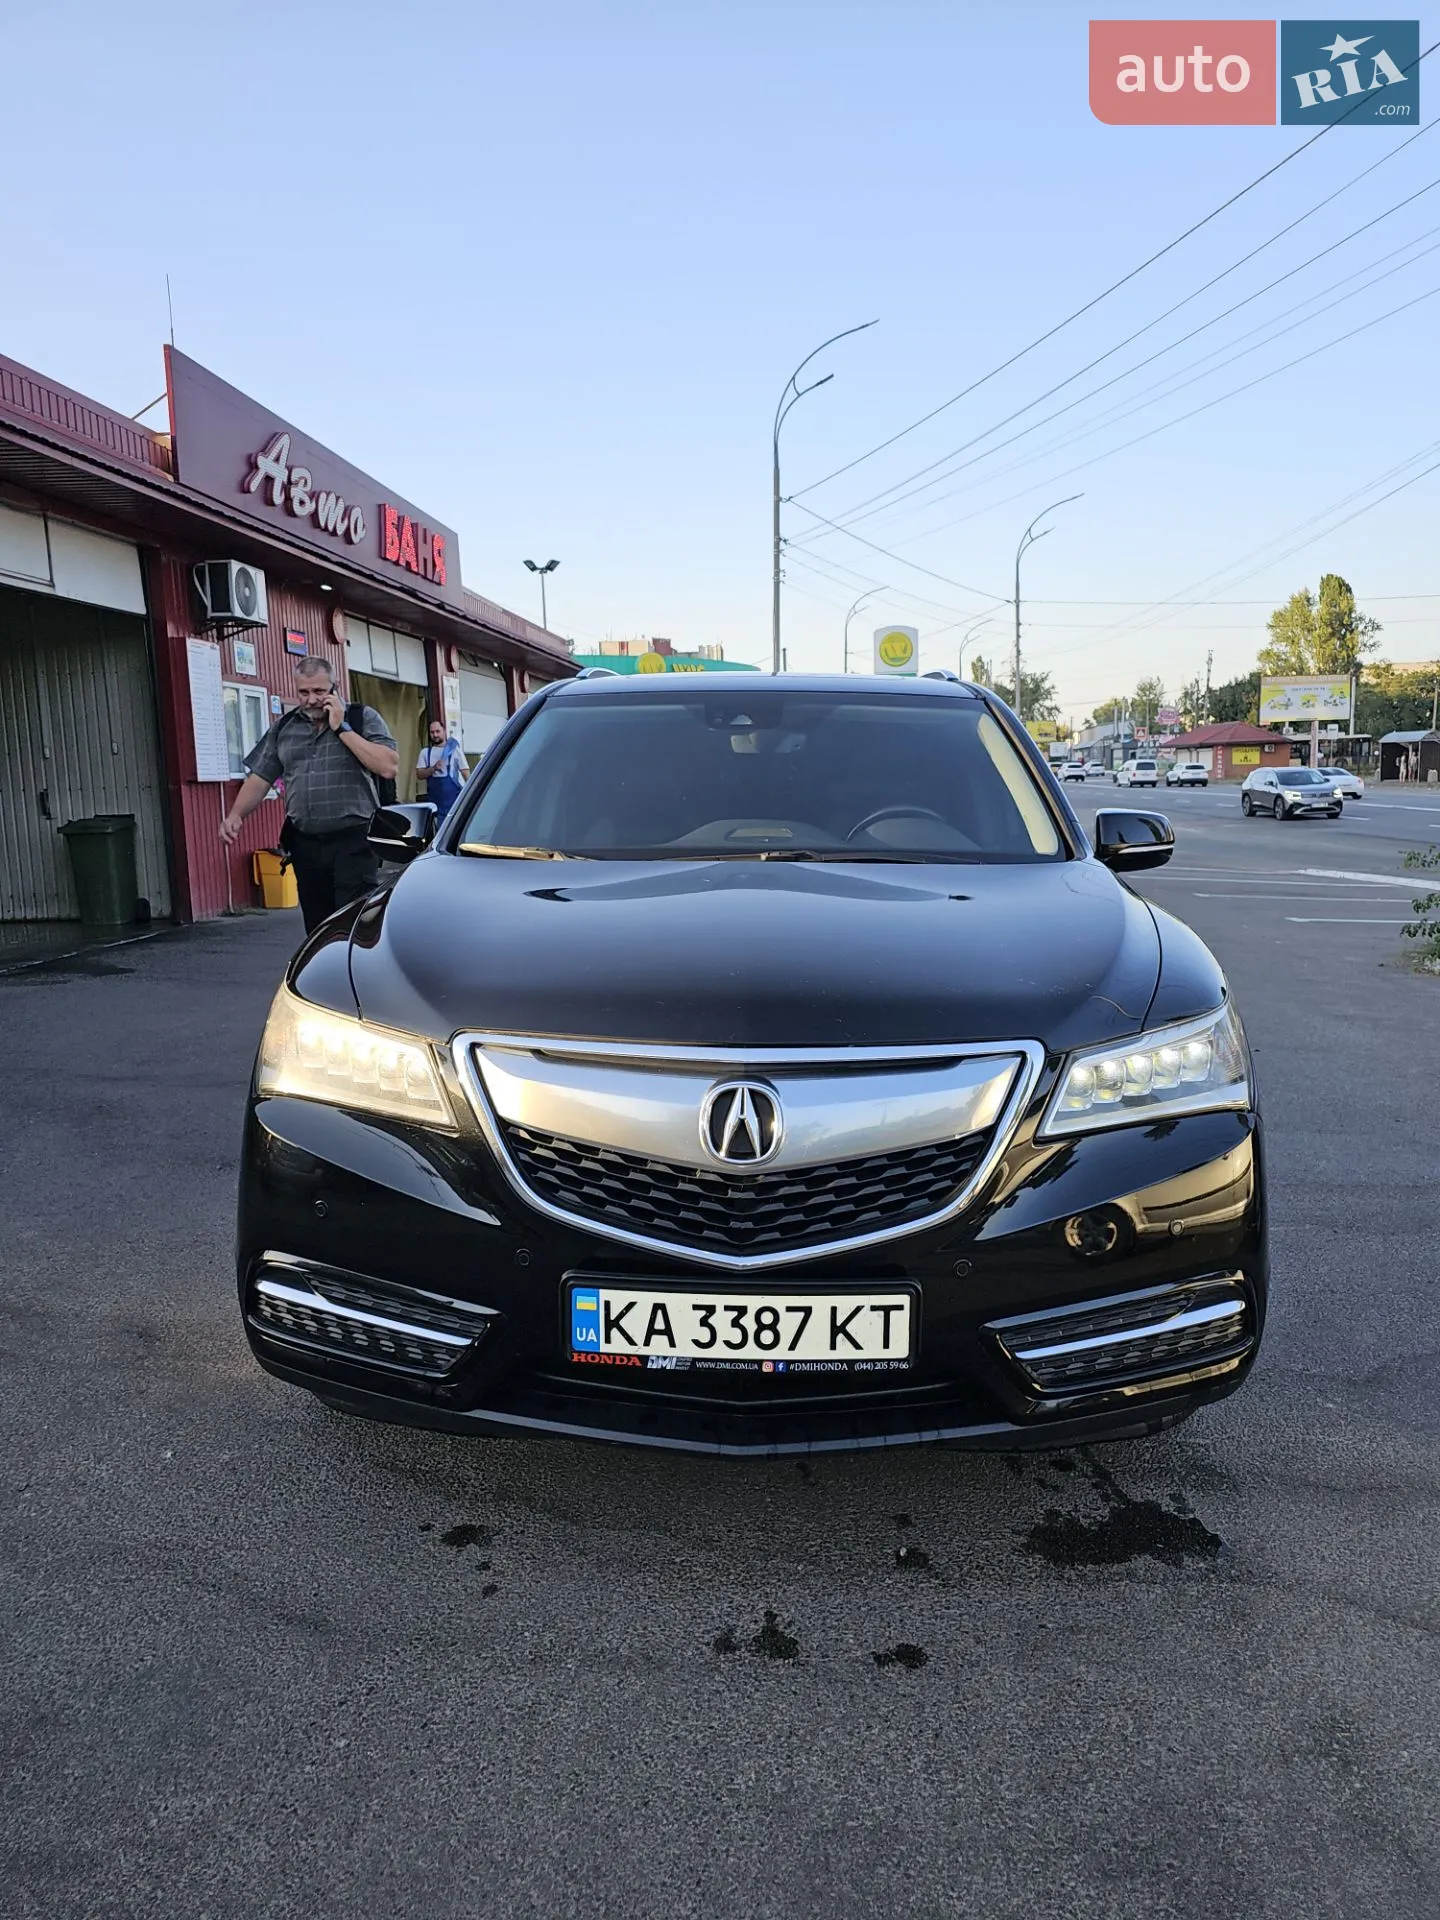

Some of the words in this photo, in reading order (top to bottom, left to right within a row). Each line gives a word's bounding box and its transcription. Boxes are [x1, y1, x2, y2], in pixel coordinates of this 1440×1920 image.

[380, 503, 446, 587] БАНЯ
[603, 1300, 677, 1348] KA
[691, 1303, 813, 1351] 3387
[829, 1304, 905, 1351] KT
[576, 1327, 598, 1343] UA
[572, 1352, 642, 1366] HONDA
[647, 1355, 677, 1370] DMI
[854, 1362, 874, 1371] (044)
[874, 1361, 888, 1370] 205
[899, 1360, 909, 1369] 66
[789, 1362, 849, 1372] #DMIHONDA
